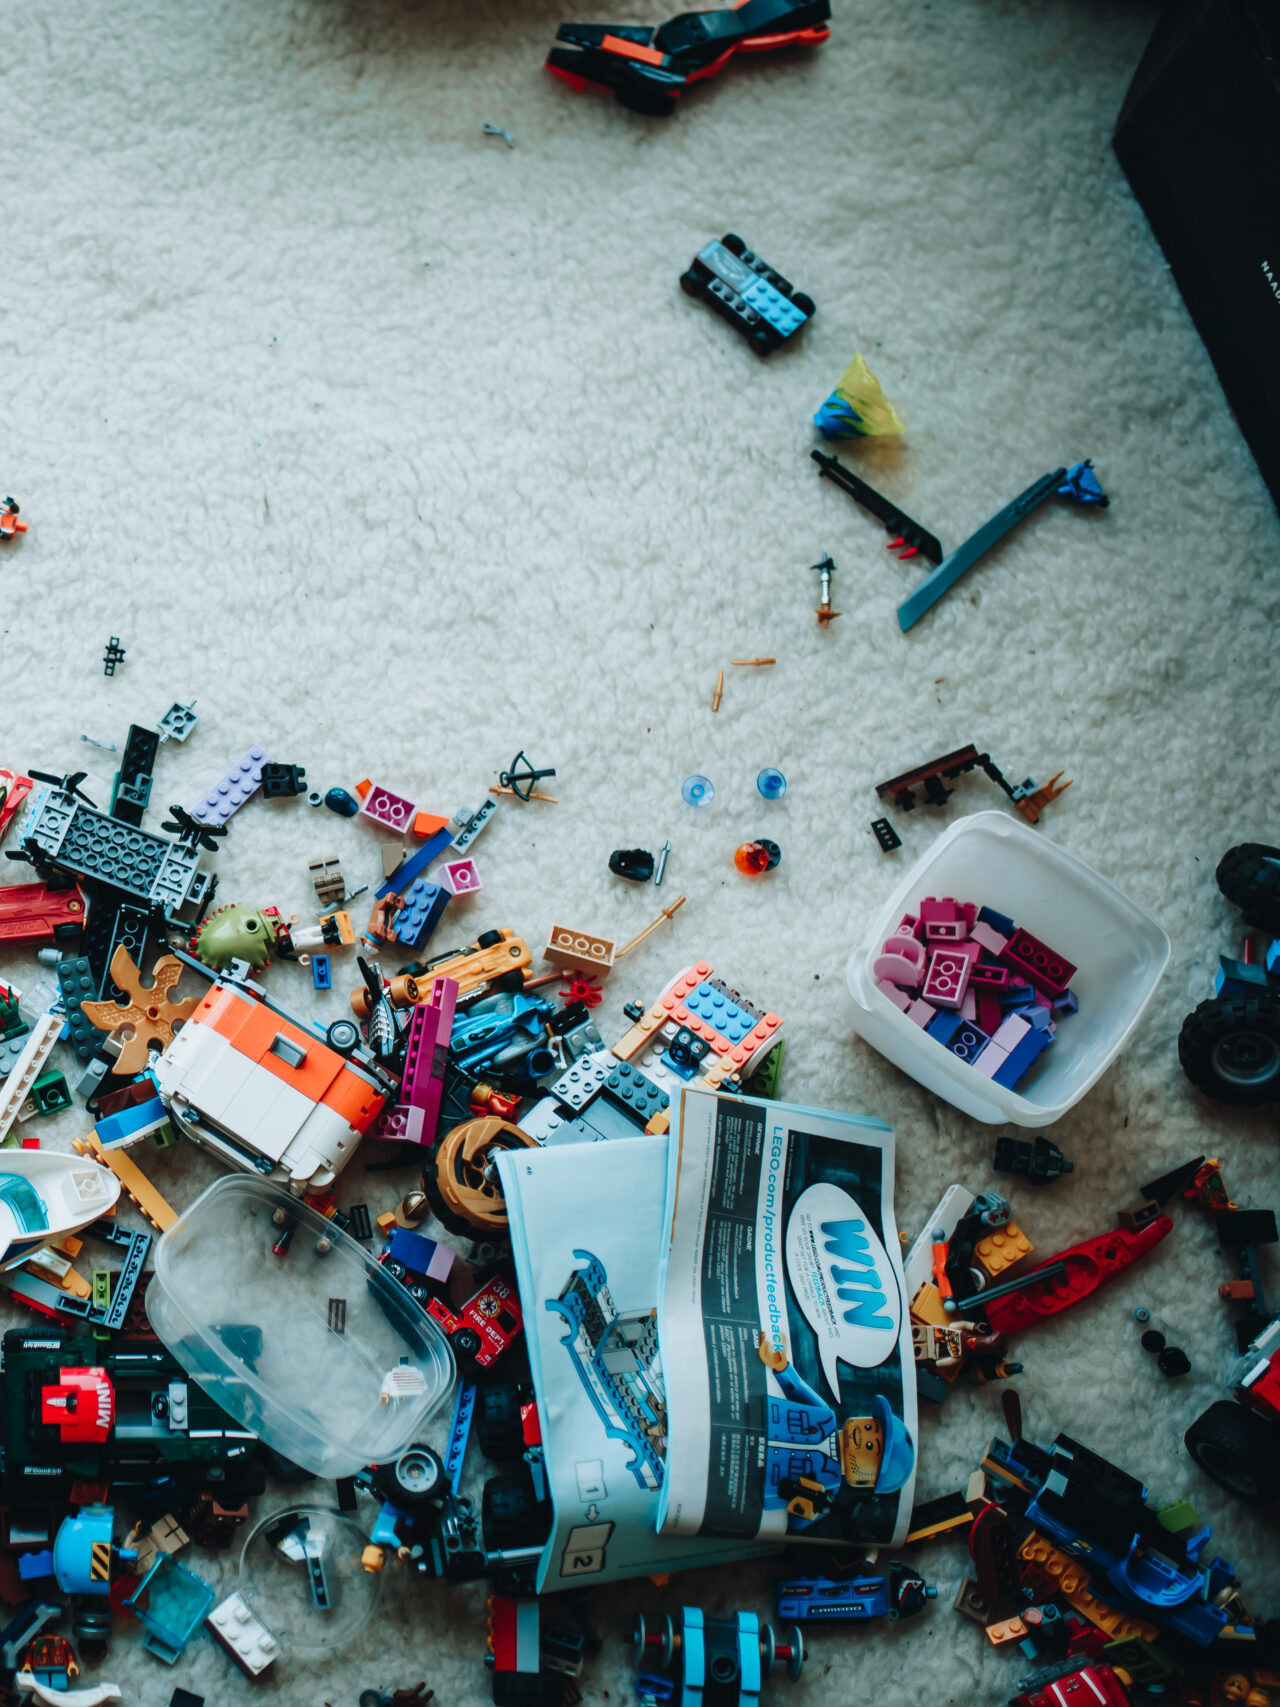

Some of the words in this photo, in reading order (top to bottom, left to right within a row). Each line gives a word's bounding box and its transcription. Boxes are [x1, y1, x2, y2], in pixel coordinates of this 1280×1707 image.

[754, 1122, 763, 1155] GEWINNE
[763, 1126, 785, 1353] LEGO.com/productfeedback
[812, 1271, 825, 1306] FEEDBACK
[820, 1219, 894, 1332] WIN
[491, 1281, 510, 1300] 38
[468, 1309, 487, 1329] FIRE
[752, 1328, 760, 1349] GANA
[95, 1382, 112, 1429] MINI
[585, 1485, 599, 1495] 1
[572, 1552, 594, 1570] 2
